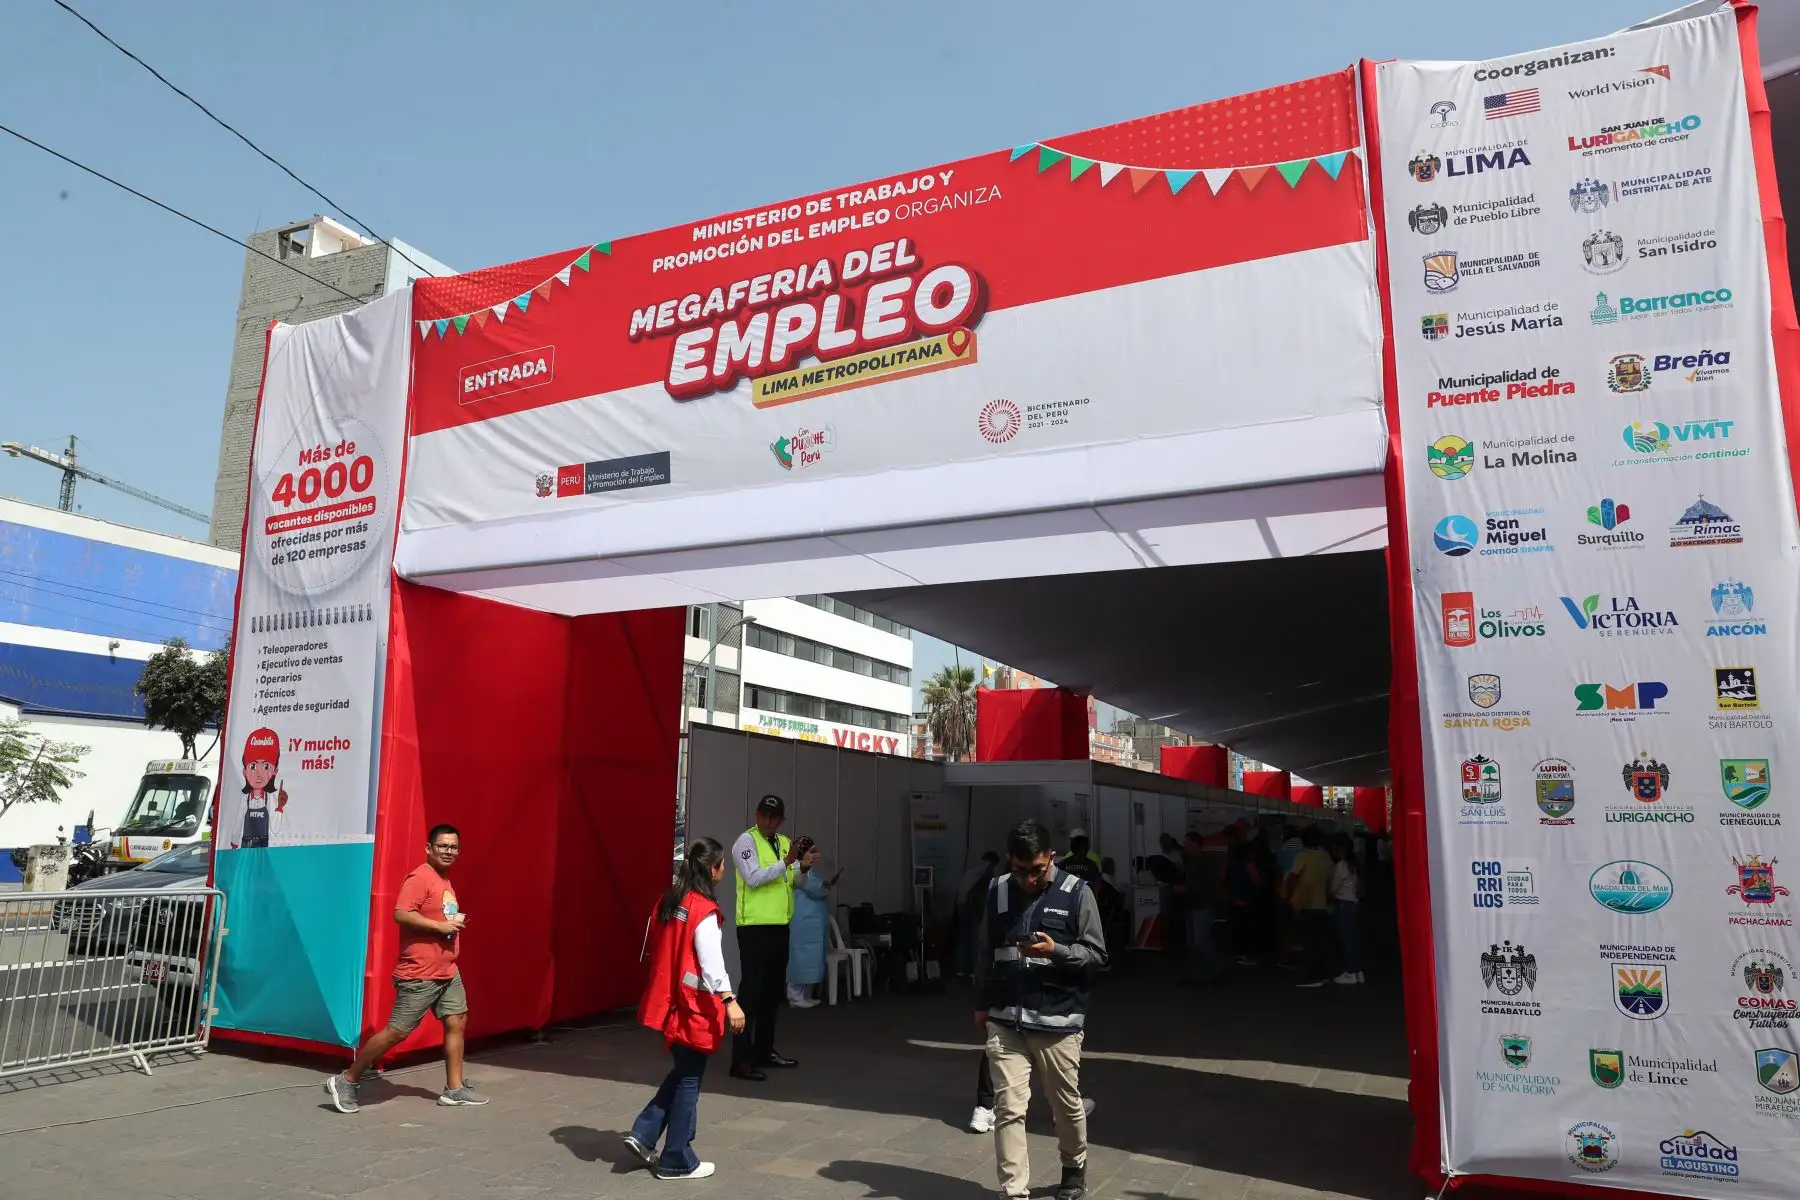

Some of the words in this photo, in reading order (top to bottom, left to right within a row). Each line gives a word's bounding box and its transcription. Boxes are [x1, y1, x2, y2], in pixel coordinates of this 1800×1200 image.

[1474, 46, 1615, 81] Coorganizan:
[1568, 85, 1609, 99] World
[1612, 76, 1654, 91] Vision
[1568, 114, 1702, 151] LURIGANCHO
[1601, 125, 1621, 133] SAN
[1623, 120, 1650, 130] JUAN
[1445, 142, 1514, 156] MUNICIPALIDAD
[1595, 142, 1642, 155] momento
[1644, 139, 1656, 147] de
[1659, 133, 1689, 144] crecer
[1446, 148, 1531, 177] LIMA
[1621, 167, 1711, 187] MUNICIPALIDAD
[1622, 183, 1671, 196] DISTRITAL
[1675, 179, 1689, 188] DE
[1693, 175, 1712, 185] ATE
[693, 202, 802, 241] MINISTERIO
[806, 195, 832, 215] DE
[836, 176, 935, 209] TRABAJO
[938, 170, 954, 187] Y
[1452, 194, 1534, 213] Municipalidad
[1454, 215, 1467, 225] de
[1470, 208, 1508, 223] Pueblo
[1511, 205, 1540, 218] Libre
[652, 234, 763, 273] PROMOCIÓN
[767, 224, 804, 246] DEL
[808, 208, 890, 239] EMPLEO
[894, 185, 1001, 221] ORGANIZA
[1637, 230, 1701, 246] Municipalidad
[1639, 244, 1668, 258] San
[1672, 238, 1717, 254] Isidro
[1460, 254, 1524, 269] MUNICIPALIDAD
[1528, 252, 1540, 260] DE
[1461, 266, 1484, 276] VILLA
[1486, 265, 1495, 273] EL
[1498, 260, 1540, 272] SALVADOR
[629, 259, 832, 337] MEGAFERIA
[841, 238, 916, 278] DEL
[1620, 288, 1732, 314] Barranco
[1457, 303, 1540, 322] Municipalidad
[1544, 301, 1558, 311] de
[669, 265, 971, 386] EMPLEO
[1455, 319, 1505, 338] Jesús
[1511, 314, 1562, 332] María
[1654, 349, 1731, 371] Breña
[464, 358, 547, 393] ENTRADA
[762, 376, 798, 396] LIMA
[801, 343, 943, 388] METROPOLITANA
[1438, 368, 1537, 389] Municipalidad
[1541, 366, 1560, 379] de
[1428, 388, 1499, 408] Puente
[1506, 379, 1575, 401] Piedra
[1027, 398, 1090, 412] BICENTENARIO
[1027, 411, 1043, 421] DEL
[1046, 408, 1068, 419] PERÚ
[1028, 421, 1044, 429] 2021
[1051, 418, 1068, 427] 2024
[1672, 421, 1734, 441] VMT
[1483, 435, 1557, 449] Municipalidad
[1561, 434, 1575, 443] de
[298, 443, 331, 467] Más
[334, 438, 356, 457] de
[801, 450, 820, 466] Perú
[1484, 455, 1505, 469] La
[1512, 450, 1577, 466] Molina
[272, 455, 374, 508] 4000
[561, 474, 580, 486] PERÚ
[588, 471, 619, 482] Ministerio
[630, 467, 655, 476] Trabajo
[593, 478, 626, 488] Promoción
[629, 476, 638, 484] del
[640, 473, 664, 484] Empleo
[268, 513, 312, 532] vacantes
[313, 501, 373, 525] disponibles
[1486, 518, 1519, 530] San
[271, 531, 321, 550] ofrecidas
[323, 528, 343, 542] por
[346, 522, 368, 535] más
[1486, 528, 1546, 545] Miguel
[1578, 531, 1644, 545] Surquillo
[1694, 525, 1740, 535] Rímac
[272, 554, 284, 566] de
[286, 549, 306, 563] 120
[308, 539, 366, 560] empresas
[1612, 597, 1640, 612] LA
[1481, 608, 1501, 618] Los
[1479, 619, 1545, 638] Olivos
[1707, 621, 1767, 637] ANCÓN
[262, 640, 328, 656] Teleoperadores
[261, 656, 300, 669] Ejecutivo
[301, 656, 312, 666] de
[314, 654, 343, 664] ventas
[260, 672, 302, 685] Operarios
[259, 687, 295, 699] Técnicos
[1574, 682, 1668, 710] SMP
[258, 702, 292, 715] Agentes
[293, 701, 303, 711] de
[305, 699, 349, 711] seguridad
[1444, 718, 1489, 729] SANTA
[1492, 717, 1531, 731] ROSA
[288, 738, 303, 752] ¡Y
[304, 736, 350, 751] mucho
[832, 728, 899, 755] VICKY
[302, 754, 334, 770] más!
[1540, 764, 1567, 772] LURÍN
[1484, 808, 1505, 816] LUIS
[1606, 812, 1694, 823] LURIGANCHO
[1720, 818, 1781, 826] CIENEGUILLA
[1472, 861, 1501, 875] CHO
[1477, 878, 1502, 891] RRI
[1600, 944, 1661, 952] MUNICIPALIDAD
[1600, 952, 1676, 961] INDEPENDENCIA
[1481, 1007, 1541, 1016] CARABAYLLO
[1738, 997, 1797, 1010] COMAS
[1733, 1009, 1800, 1020] Construyendo
[1749, 1019, 1789, 1028] Futuros
[1628, 1055, 1717, 1072] Municipalidad
[1477, 1072, 1560, 1085] MUNICIPALIDAD
[1629, 1071, 1643, 1082] de
[1648, 1072, 1687, 1085] Lince
[1482, 1082, 1496, 1091] DE
[1498, 1084, 1521, 1093] SAN
[1524, 1085, 1556, 1095] BORJA
[1774, 1097, 1795, 1105] JUAN
[1660, 1140, 1737, 1161] Ciudad
[1662, 1159, 1675, 1169] EL
[1677, 1161, 1737, 1174] AGUSTINO
